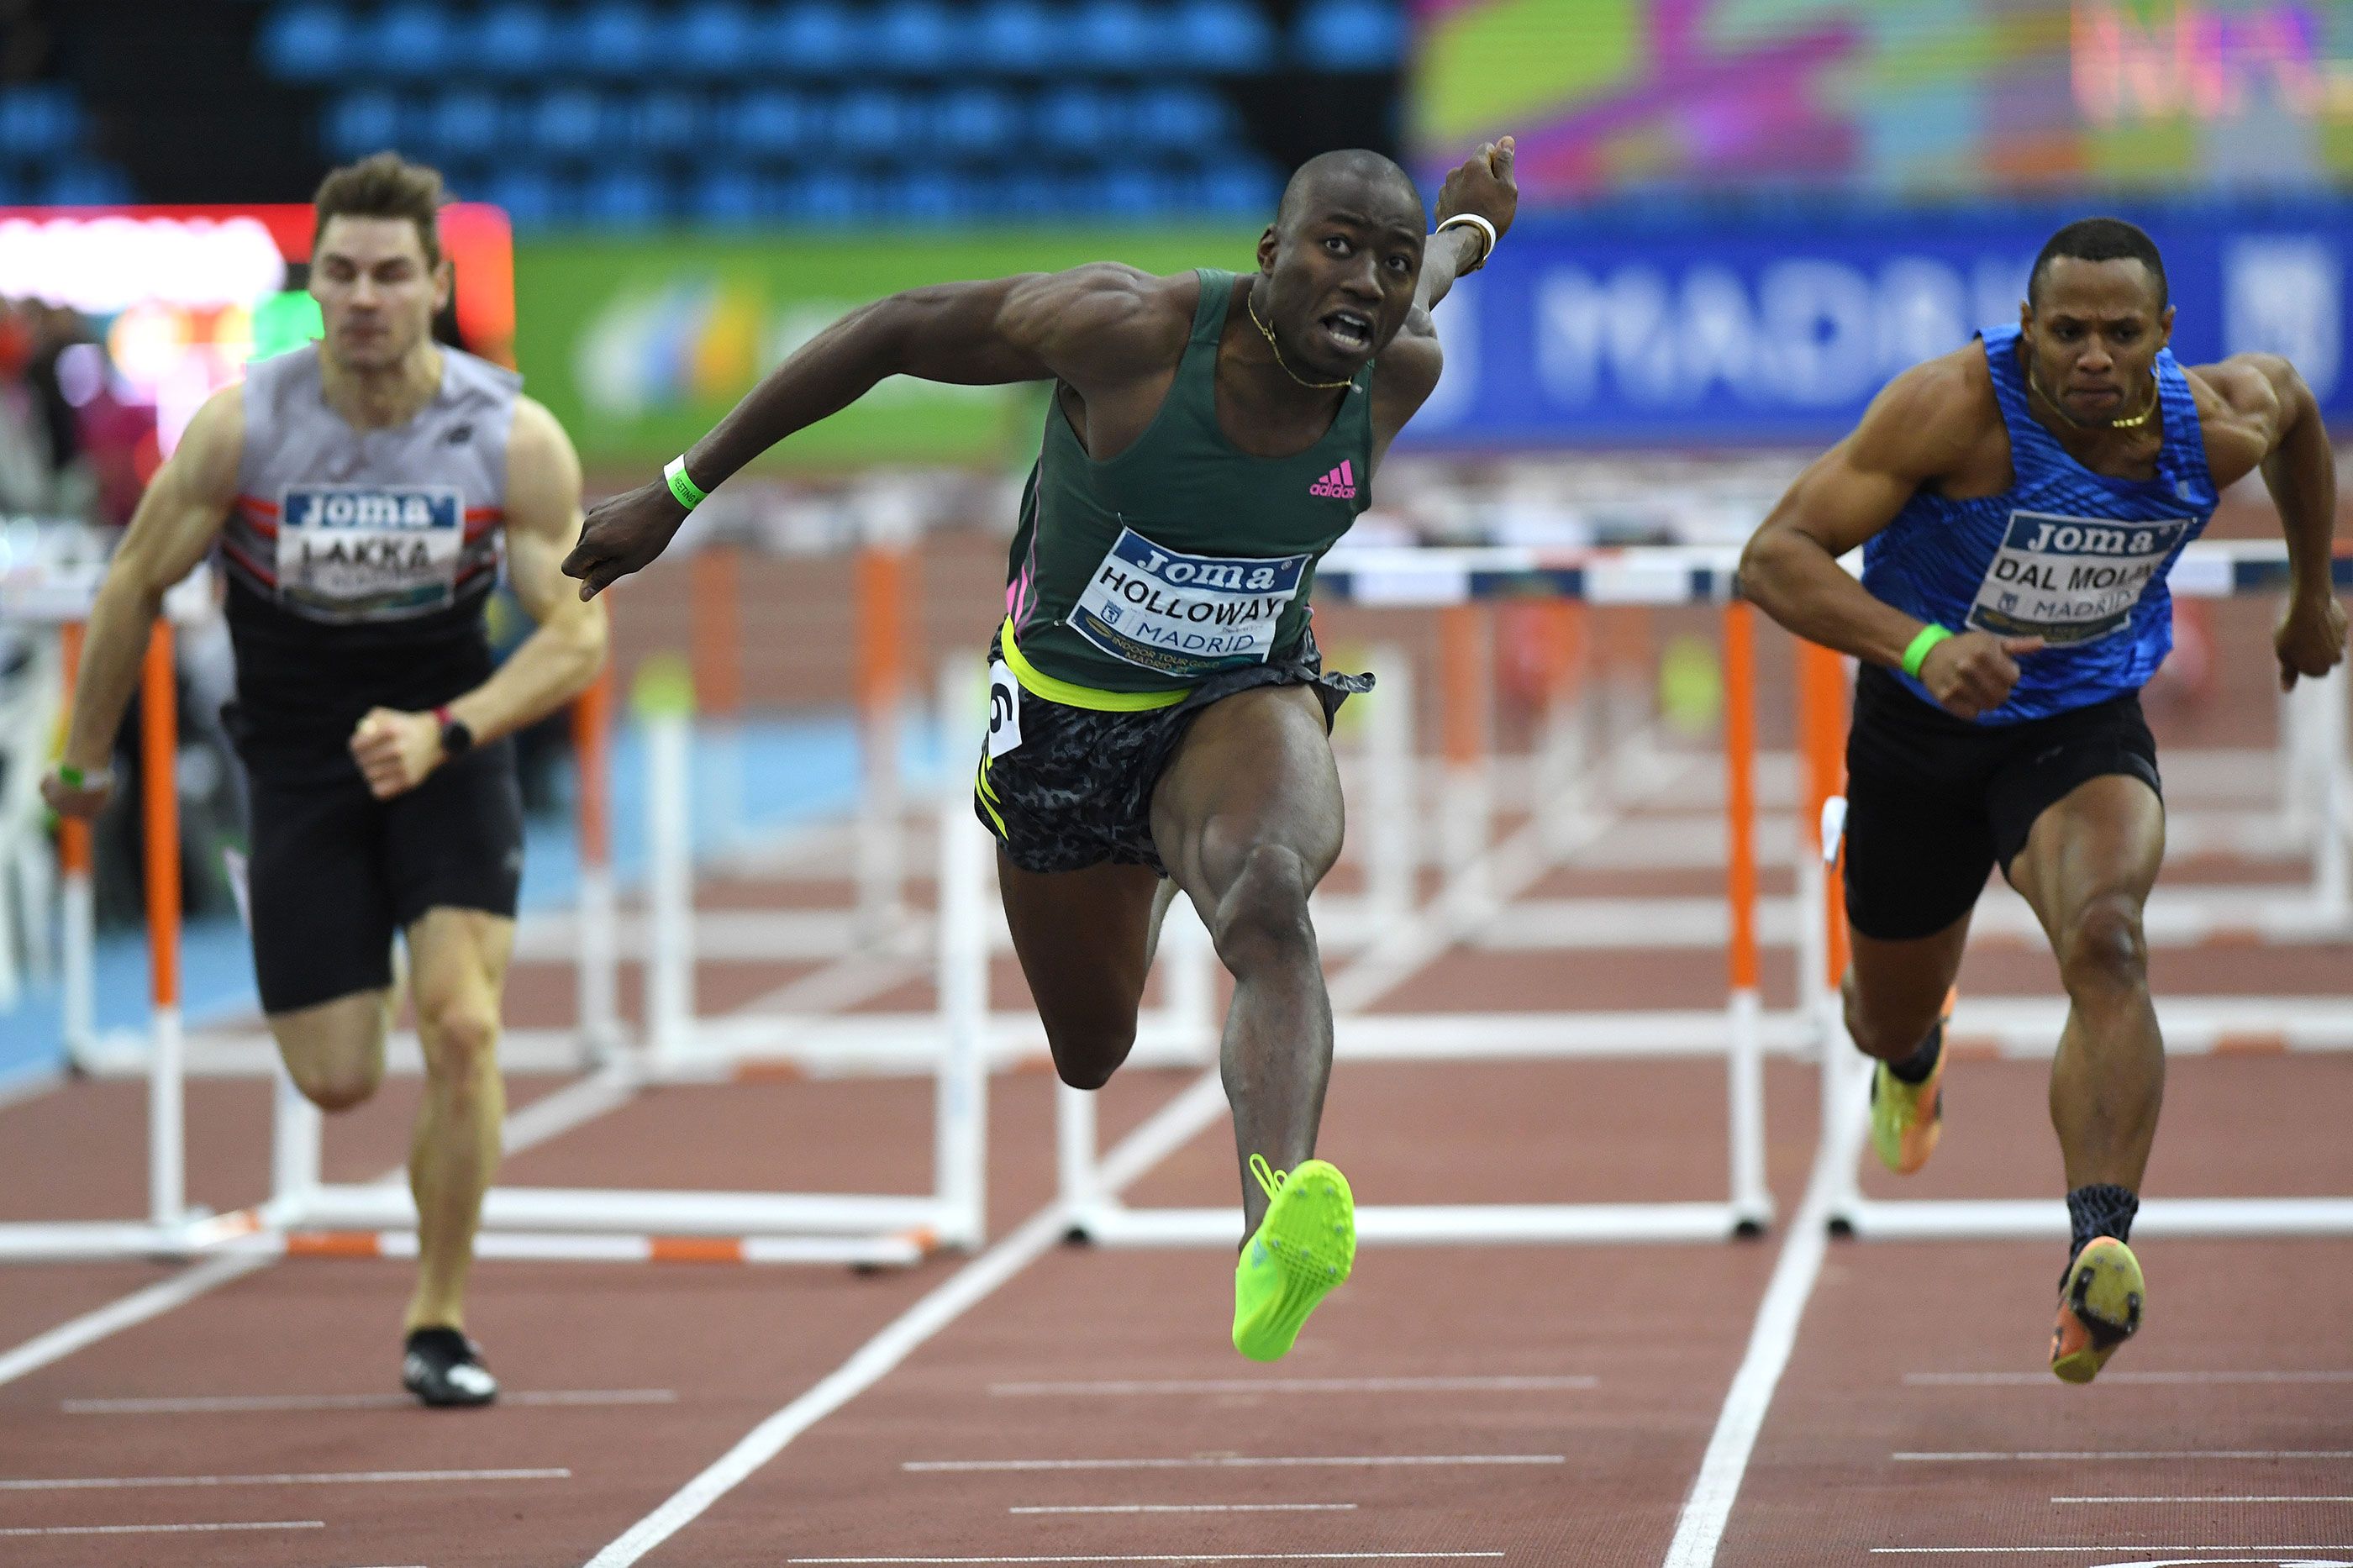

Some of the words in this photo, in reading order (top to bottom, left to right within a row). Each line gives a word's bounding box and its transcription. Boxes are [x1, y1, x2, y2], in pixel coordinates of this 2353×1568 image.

[1309, 482, 1355, 499] adidas
[1995, 558, 2056, 590] DAL
[1099, 566, 1282, 625] HOLLOWAY
[1136, 622, 1255, 653] MADRID
